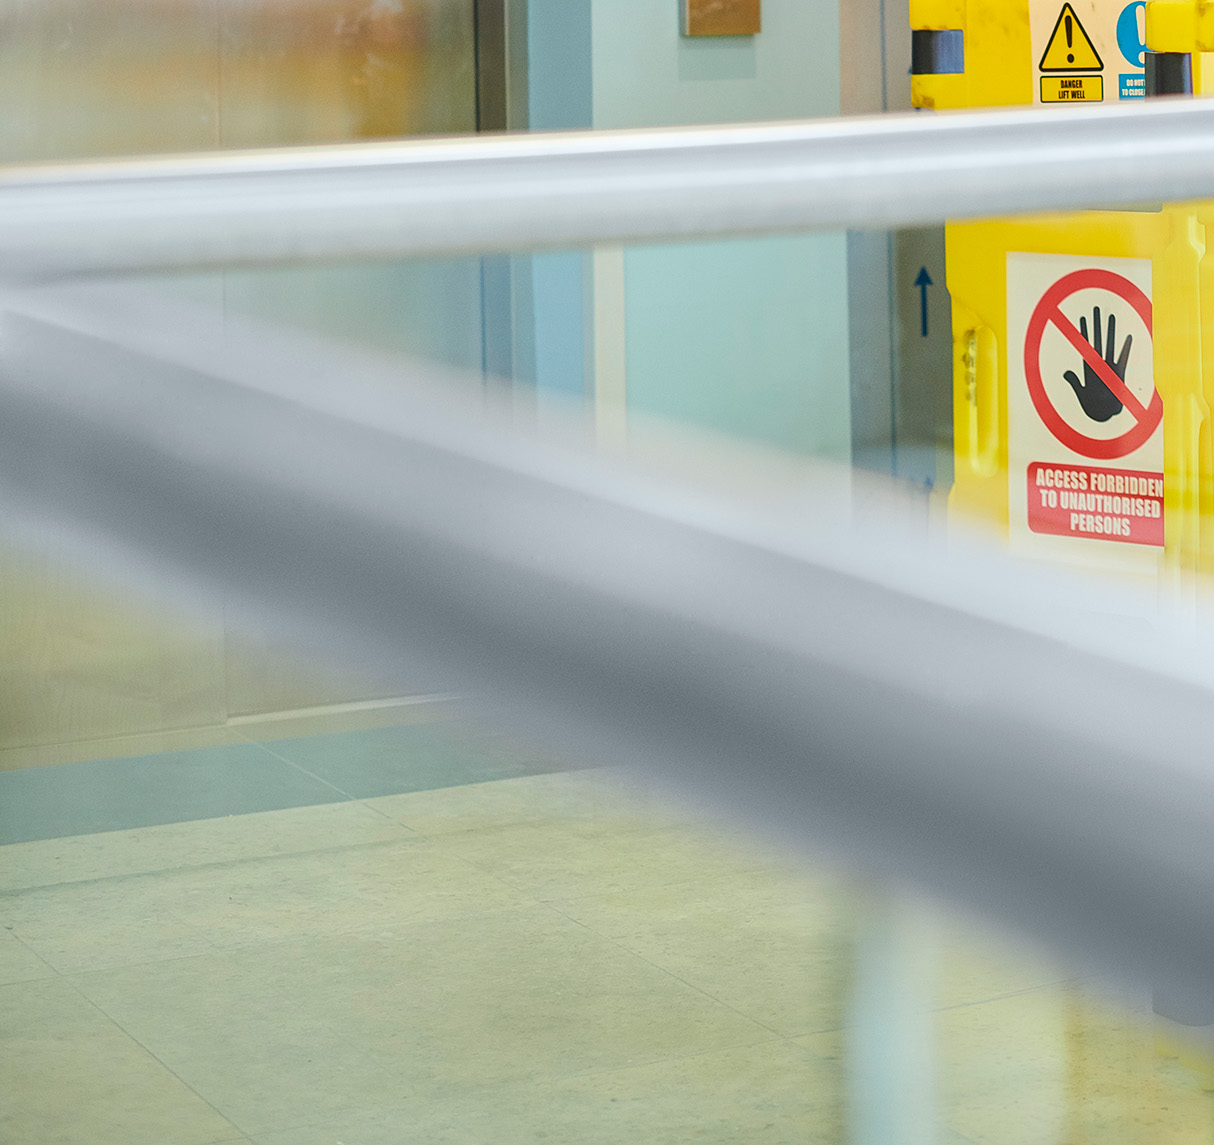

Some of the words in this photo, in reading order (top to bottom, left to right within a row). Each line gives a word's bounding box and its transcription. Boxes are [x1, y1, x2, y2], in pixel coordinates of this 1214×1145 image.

[1058, 90, 1070, 99] LIFT
[1071, 89, 1086, 99] WELL
[1060, 79, 1083, 89] DANGER
[1036, 468, 1088, 490] ACCESS
[1090, 473, 1163, 497] FORBIDDEN
[1040, 489, 1057, 508] TO
[1060, 491, 1161, 518] UNAUTHORISED
[1070, 513, 1131, 536] PERSONS
